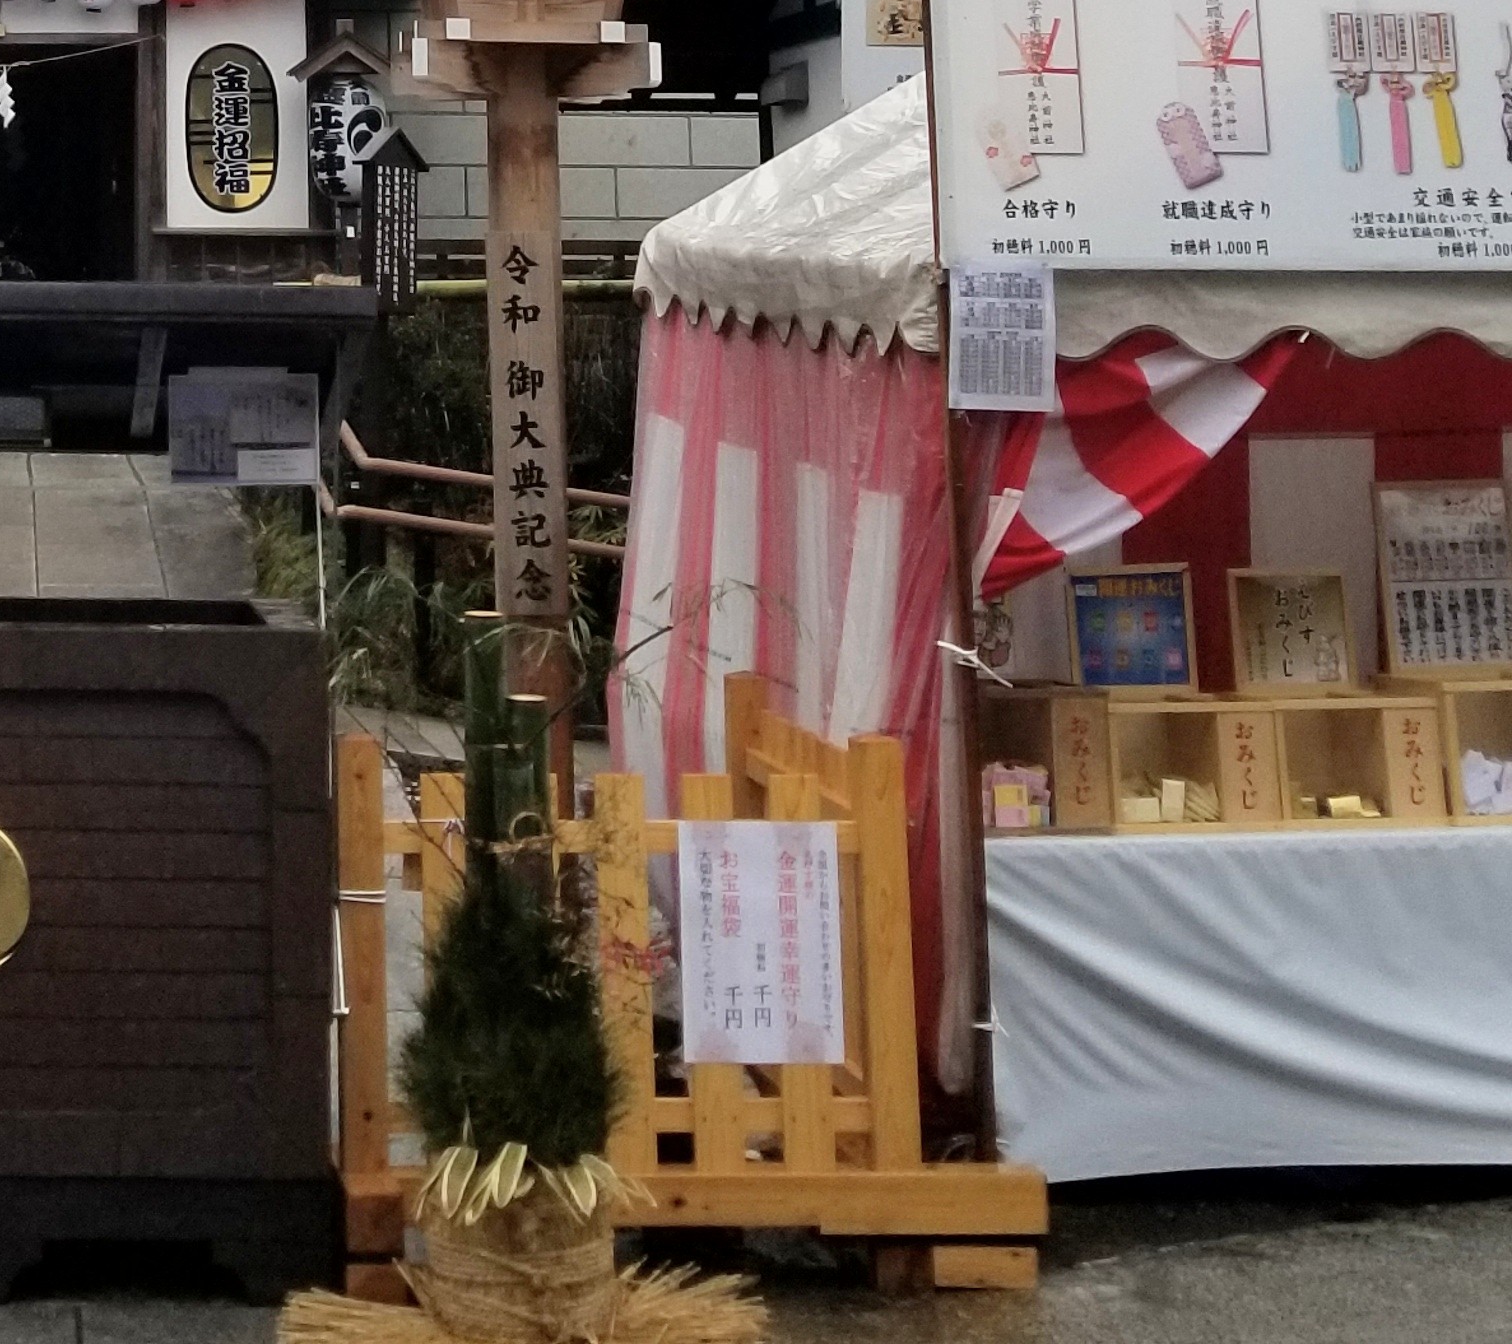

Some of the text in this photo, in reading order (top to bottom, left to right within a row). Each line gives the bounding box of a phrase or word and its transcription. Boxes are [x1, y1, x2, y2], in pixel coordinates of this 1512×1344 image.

[214, 62, 250, 194] 金運招福
[1003, 199, 1076, 219] 合格守り
[1162, 201, 1271, 220] 就職達成守り
[1413, 187, 1512, 207] 交通安全
[1039, 240, 1074, 254] 1,000
[1217, 240, 1251, 255] 1,000
[1484, 243, 1512, 257] 1,00
[501, 245, 552, 602] 令和 御大典記念
[1235, 721, 1256, 810] おみくじ
[1402, 717, 1424, 805] おみくじ
[724, 985, 743, 1029] 千円
[754, 984, 772, 1028] 千円
